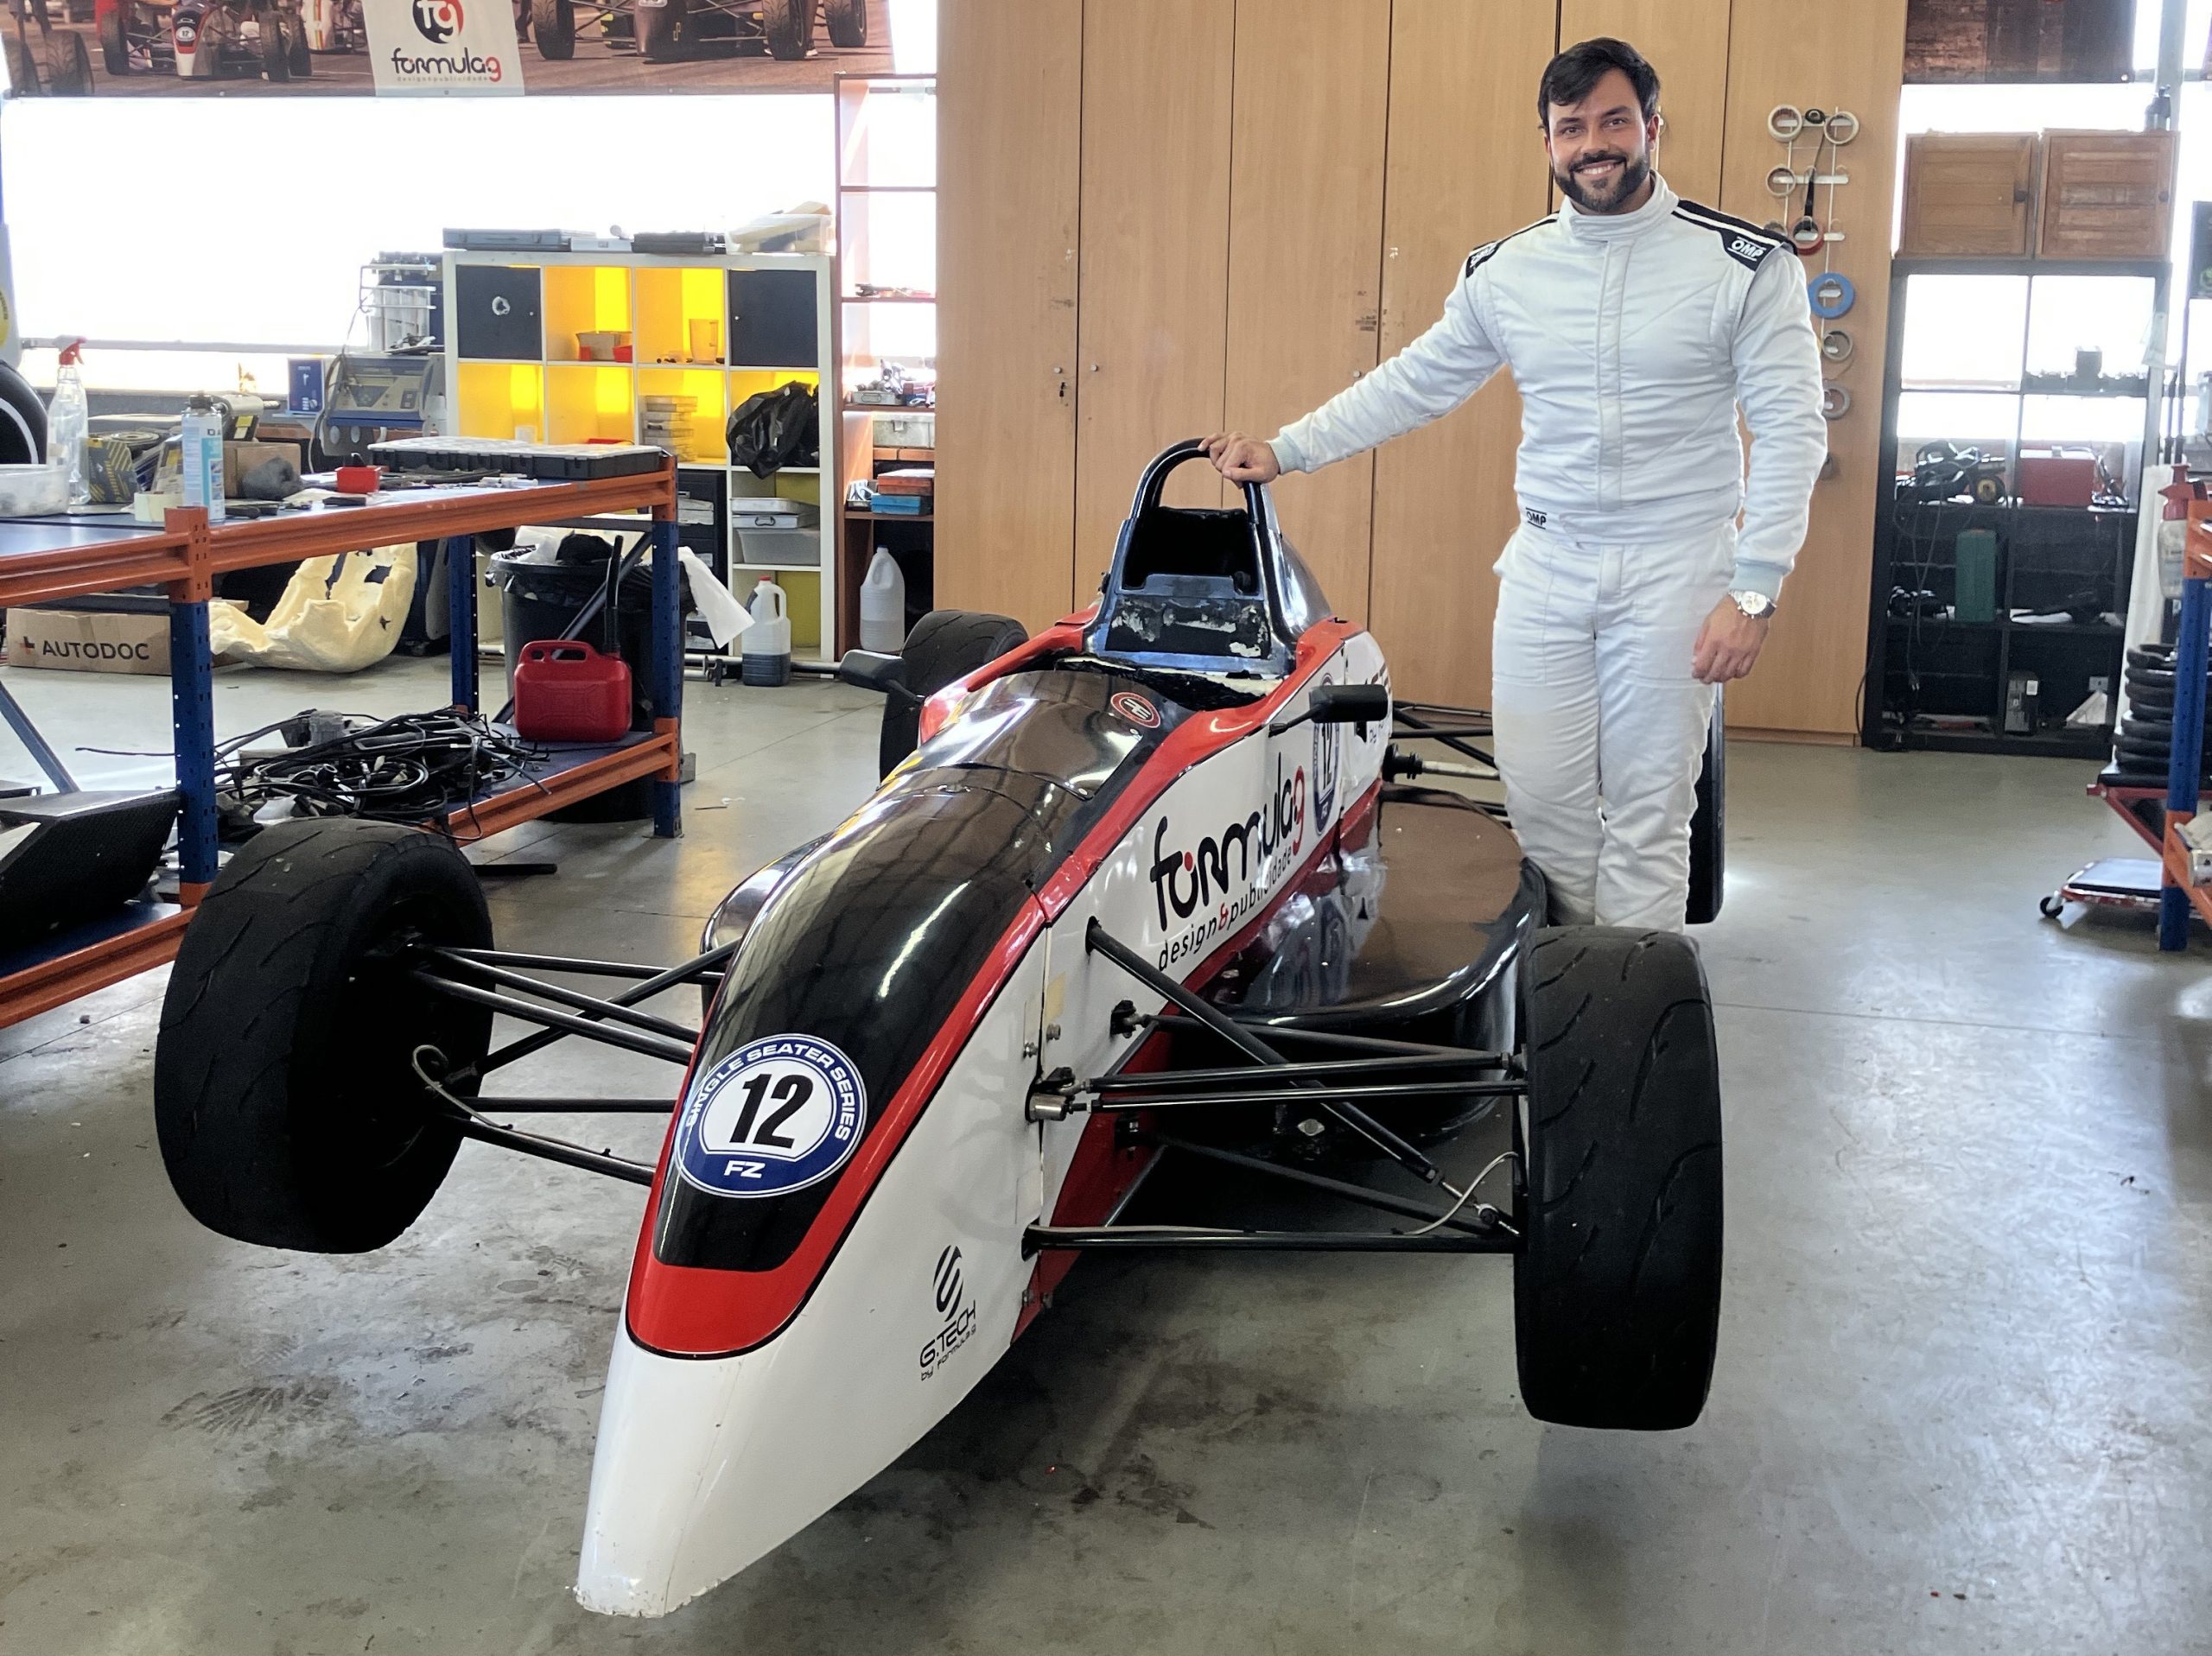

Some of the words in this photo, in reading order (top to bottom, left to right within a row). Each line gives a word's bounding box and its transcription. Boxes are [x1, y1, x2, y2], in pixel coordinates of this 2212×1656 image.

[1731, 239, 1764, 257] OMP
[1526, 511, 1547, 525] OMP
[42, 640, 150, 660] AUTODOC
[746, 1043, 836, 1069] SEATER
[830, 1066, 856, 1142] SERIES
[728, 1073, 814, 1150] 12
[723, 1160, 766, 1179] FZ
[920, 1367, 934, 1382] by
